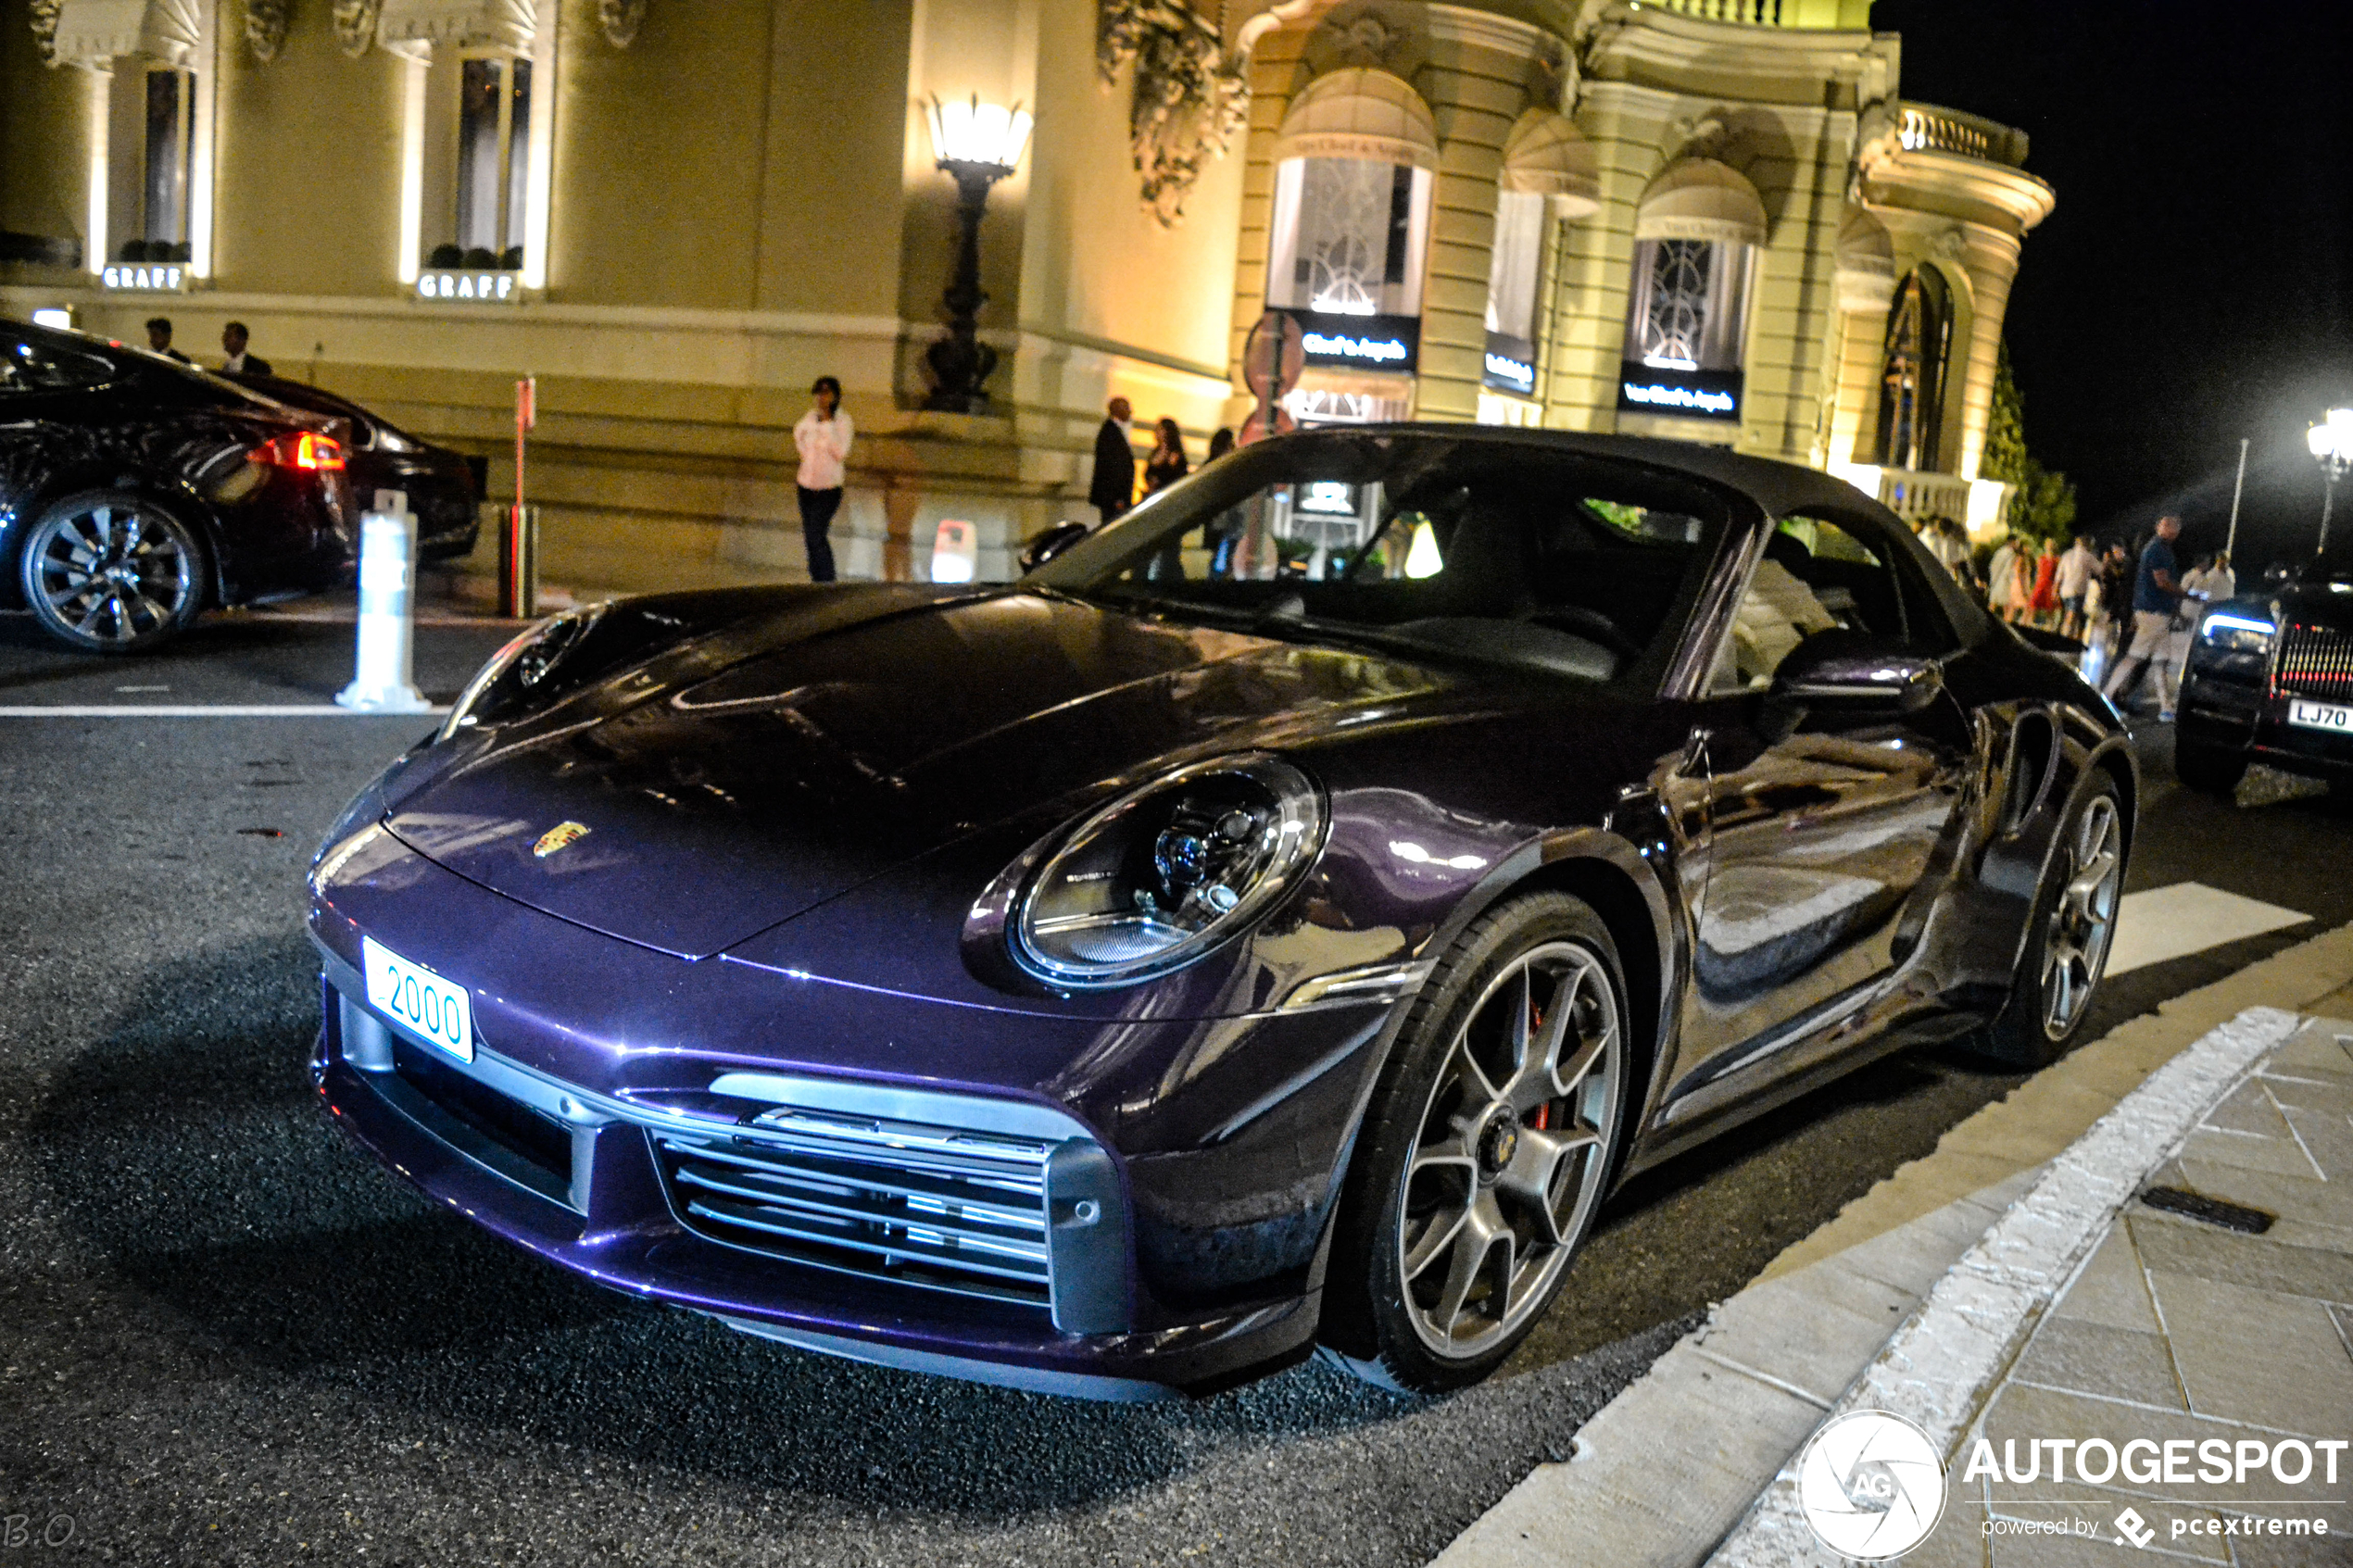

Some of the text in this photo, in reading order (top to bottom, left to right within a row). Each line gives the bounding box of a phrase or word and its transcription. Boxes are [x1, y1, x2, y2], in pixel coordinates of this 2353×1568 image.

[104, 267, 181, 288] GRAFF
[419, 274, 511, 298] GRAFF
[2297, 705, 2347, 726] LJ70
[388, 965, 461, 1045] 2000
